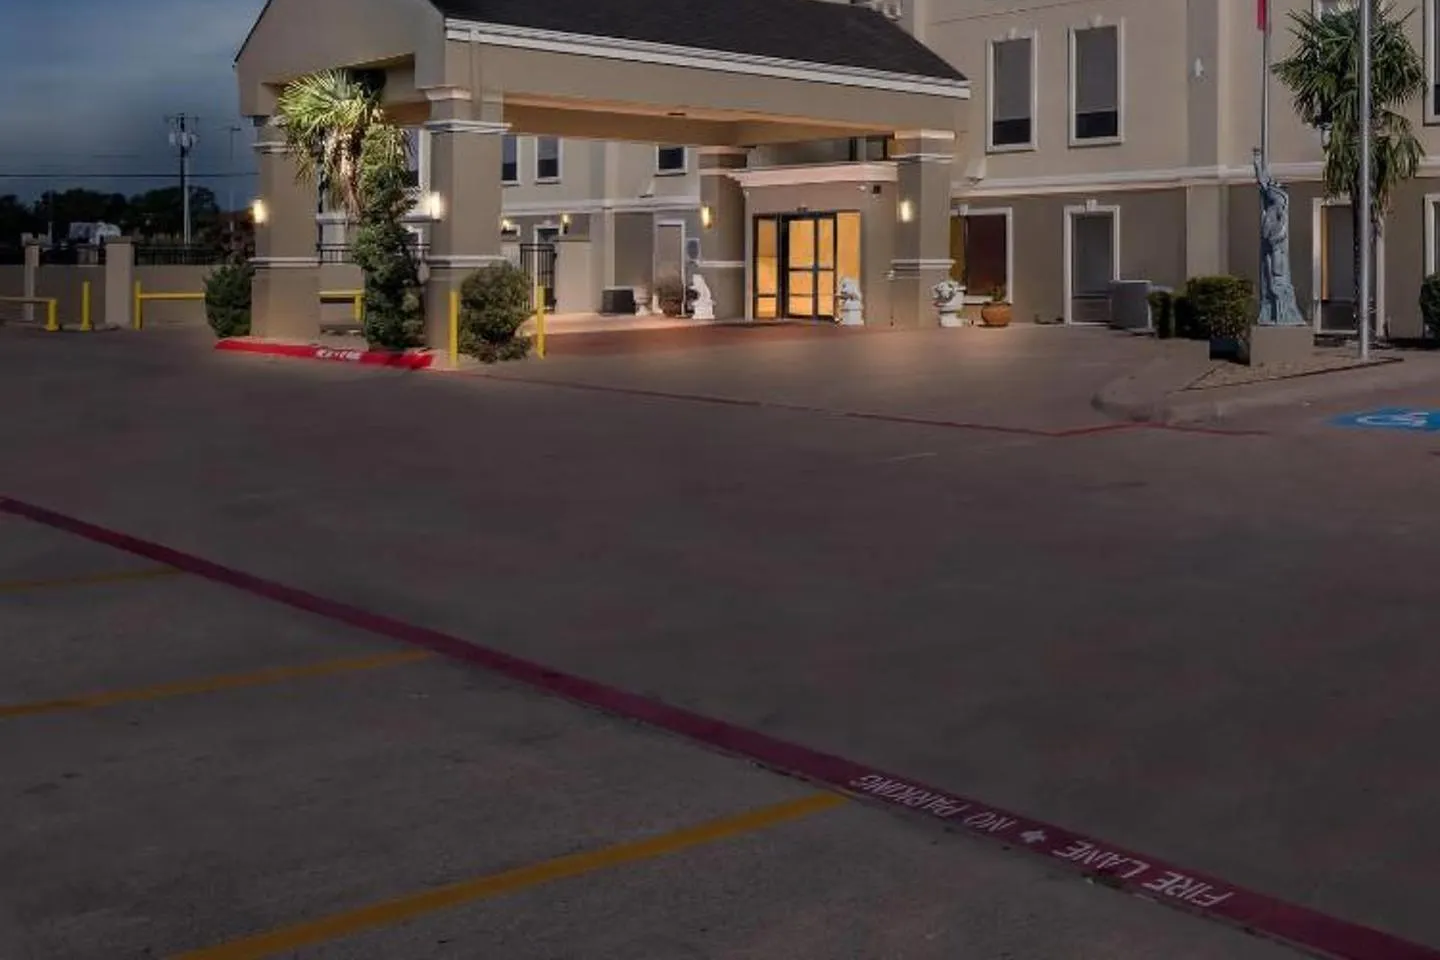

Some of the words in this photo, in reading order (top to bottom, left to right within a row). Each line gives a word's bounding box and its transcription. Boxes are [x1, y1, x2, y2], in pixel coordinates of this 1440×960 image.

[859, 773, 969, 817] PARKING
[964, 811, 1016, 833] NO
[1052, 839, 1150, 879] LANE
[1143, 871, 1235, 907] FIRE
